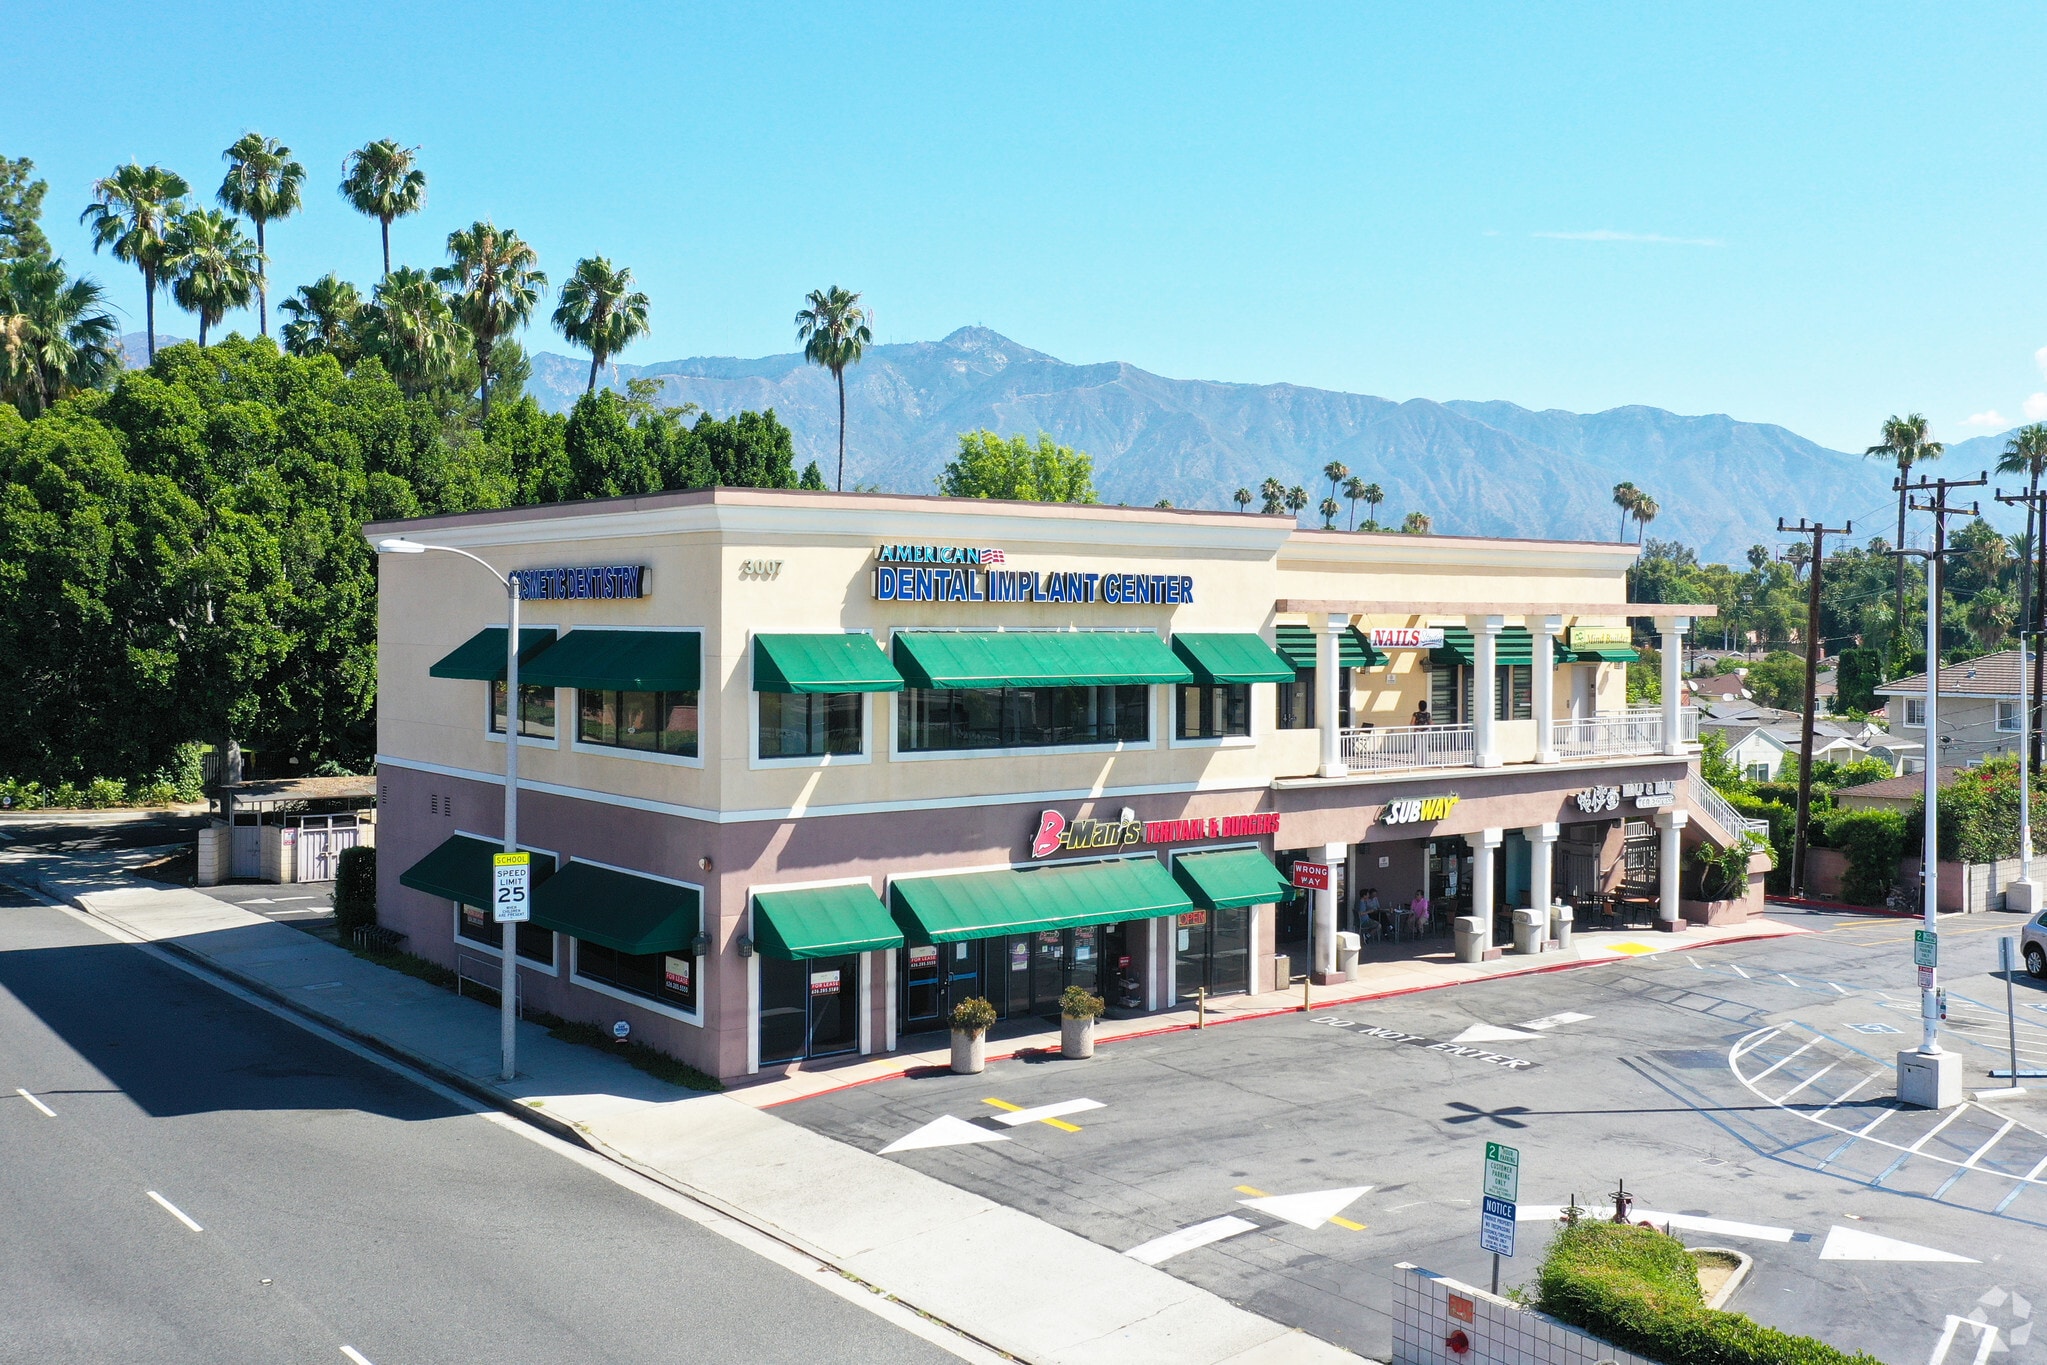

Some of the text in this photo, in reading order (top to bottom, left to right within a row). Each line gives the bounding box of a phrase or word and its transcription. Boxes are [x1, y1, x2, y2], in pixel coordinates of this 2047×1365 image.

[879, 545, 980, 565] AMERICAN
[743, 559, 784, 575] 3007
[567, 565, 639, 600] DENTISTRY
[877, 566, 1194, 605] DENTAL IMPLANT CENTER
[1372, 629, 1420, 647] NAILS
[1385, 795, 1460, 826] SUBWAY
[1144, 817, 1206, 844] TERIYAKI
[1208, 816, 1220, 839] &
[1221, 812, 1280, 838] BURGERS
[496, 856, 527, 864] SCHOOL
[497, 869, 526, 878] SPEED
[1295, 864, 1328, 876] WRONG
[500, 878, 522, 886] LIMIT
[1301, 876, 1321, 886] WAY
[498, 886, 525, 903] 25
[1180, 911, 1206, 925] OPEN
[666, 972, 688, 985] FOR LEASE
[1310, 1016, 1531, 1069] DO NOT ENTER
[1489, 1145, 1496, 1158] 2
[1500, 1154, 1516, 1164] PARKING
[1490, 1162, 1513, 1174] CUSTOMER
[1491, 1169, 1511, 1181] PARKING
[1494, 1178, 1506, 1187] ONLY
[1486, 1199, 1513, 1218] NOTICE
